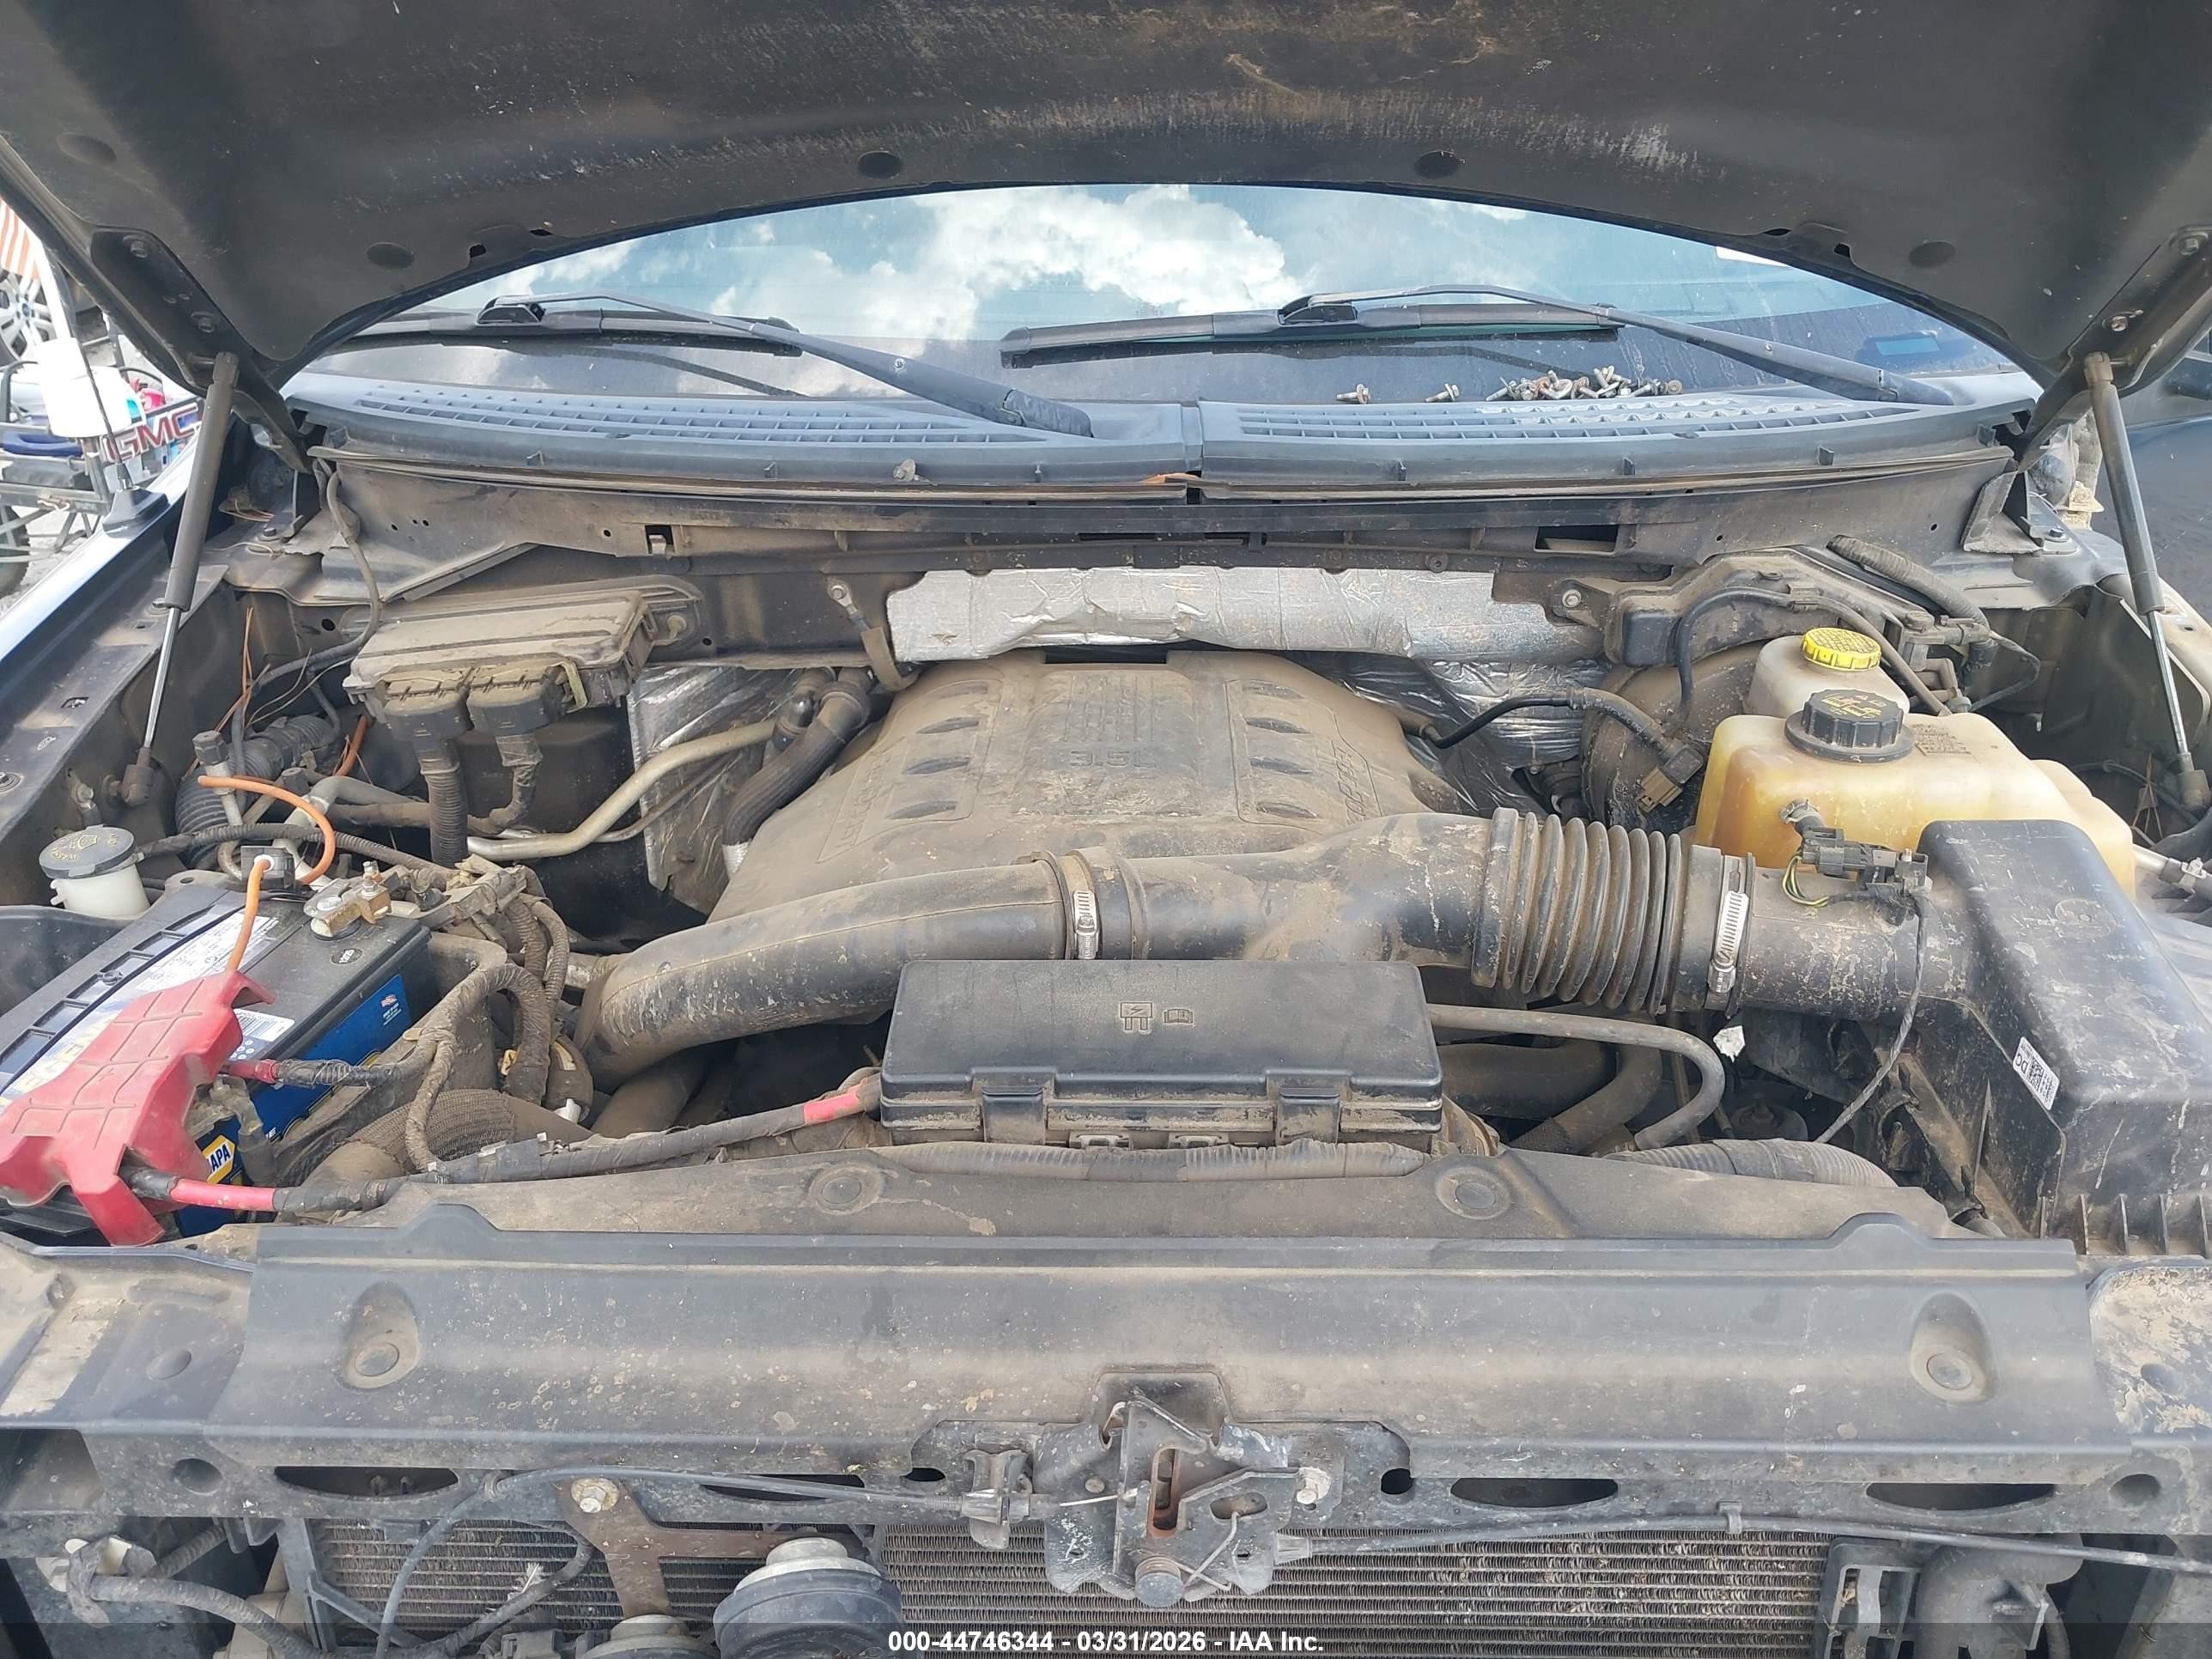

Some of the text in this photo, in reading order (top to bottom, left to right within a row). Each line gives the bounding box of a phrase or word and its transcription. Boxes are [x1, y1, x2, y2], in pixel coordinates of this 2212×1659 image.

[102, 403, 199, 464] GMC
[1070, 750, 1158, 769] 3.5L
[2014, 1053, 2028, 1074] DC
[207, 1144, 231, 1173] APA
